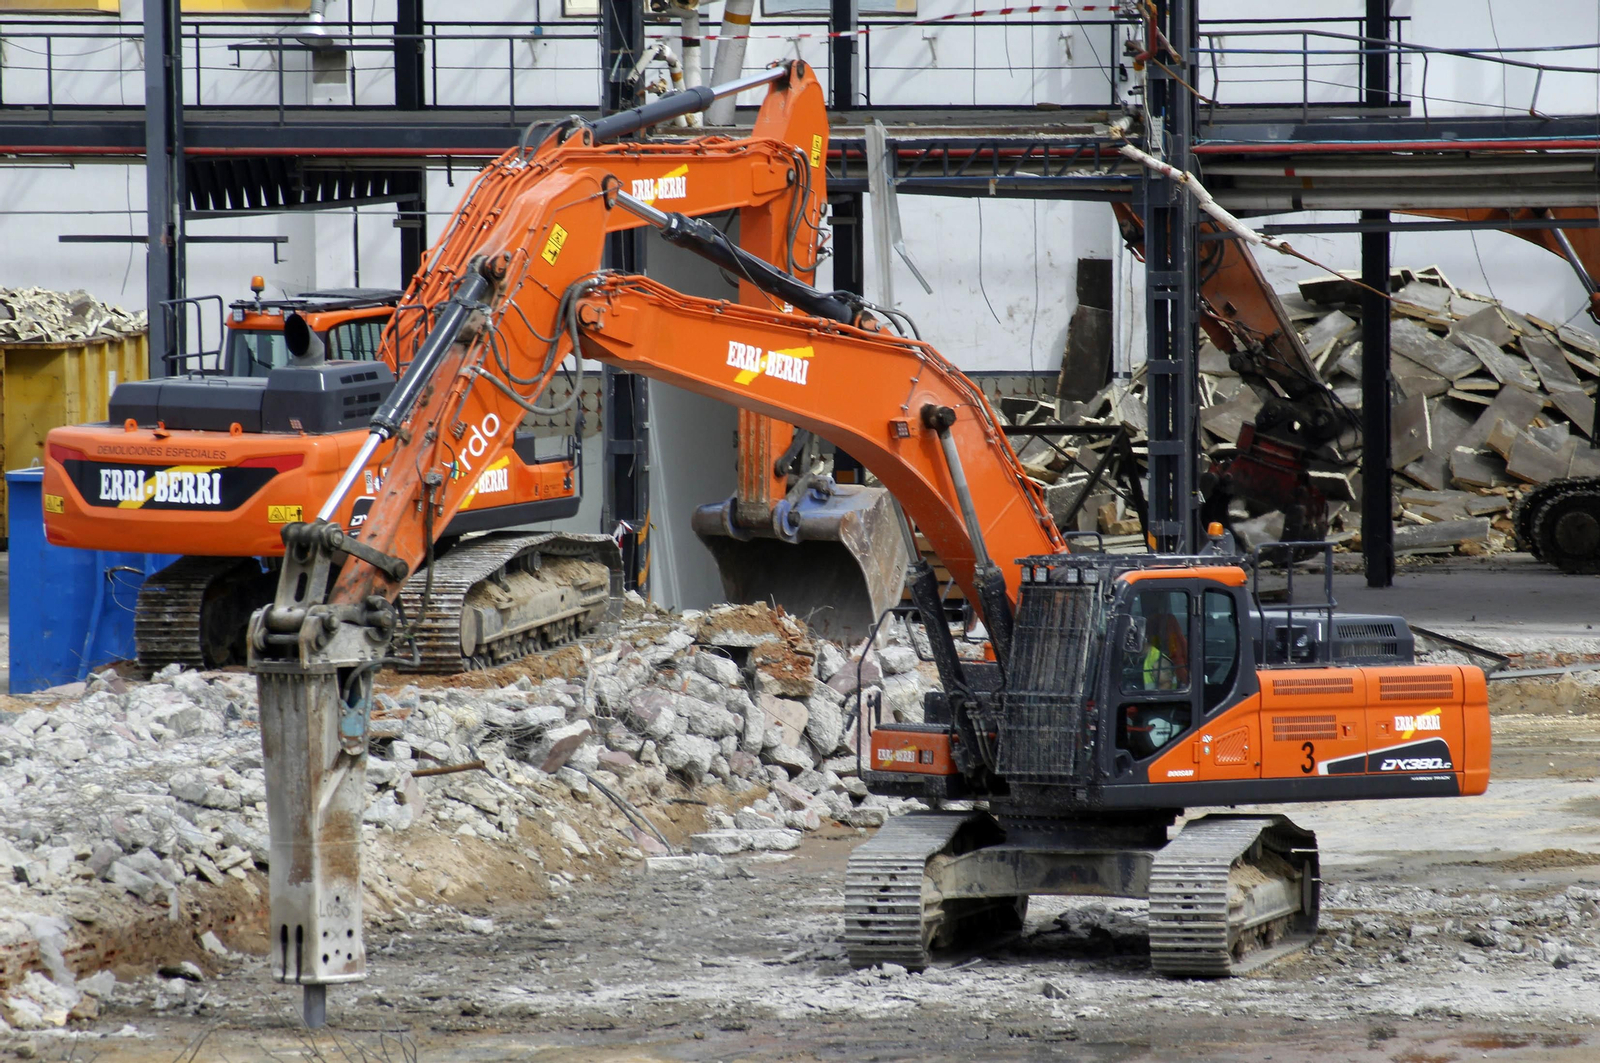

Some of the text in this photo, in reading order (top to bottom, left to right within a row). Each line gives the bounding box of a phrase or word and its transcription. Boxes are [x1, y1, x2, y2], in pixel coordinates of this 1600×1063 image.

[97, 445, 227, 460] DEMOLICIONES ESPECIALES
[1301, 741, 1315, 774] 3
